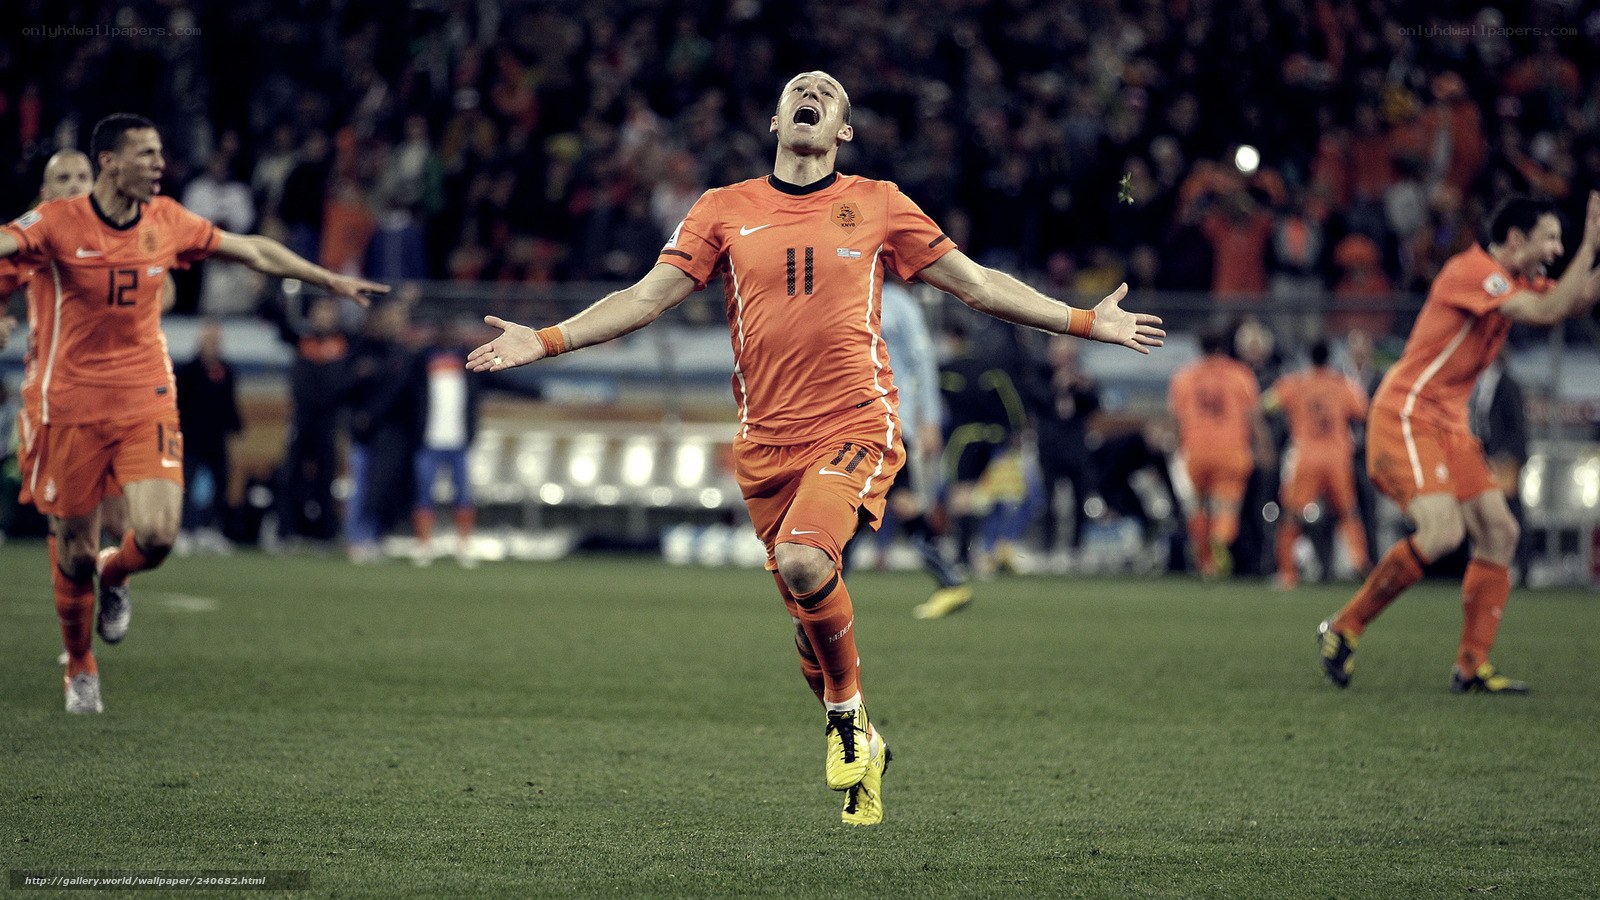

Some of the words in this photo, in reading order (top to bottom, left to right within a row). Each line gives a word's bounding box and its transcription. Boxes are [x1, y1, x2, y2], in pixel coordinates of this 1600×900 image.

[107, 269, 138, 305] 12
[786, 246, 814, 297] 11
[830, 442, 869, 474] 11
